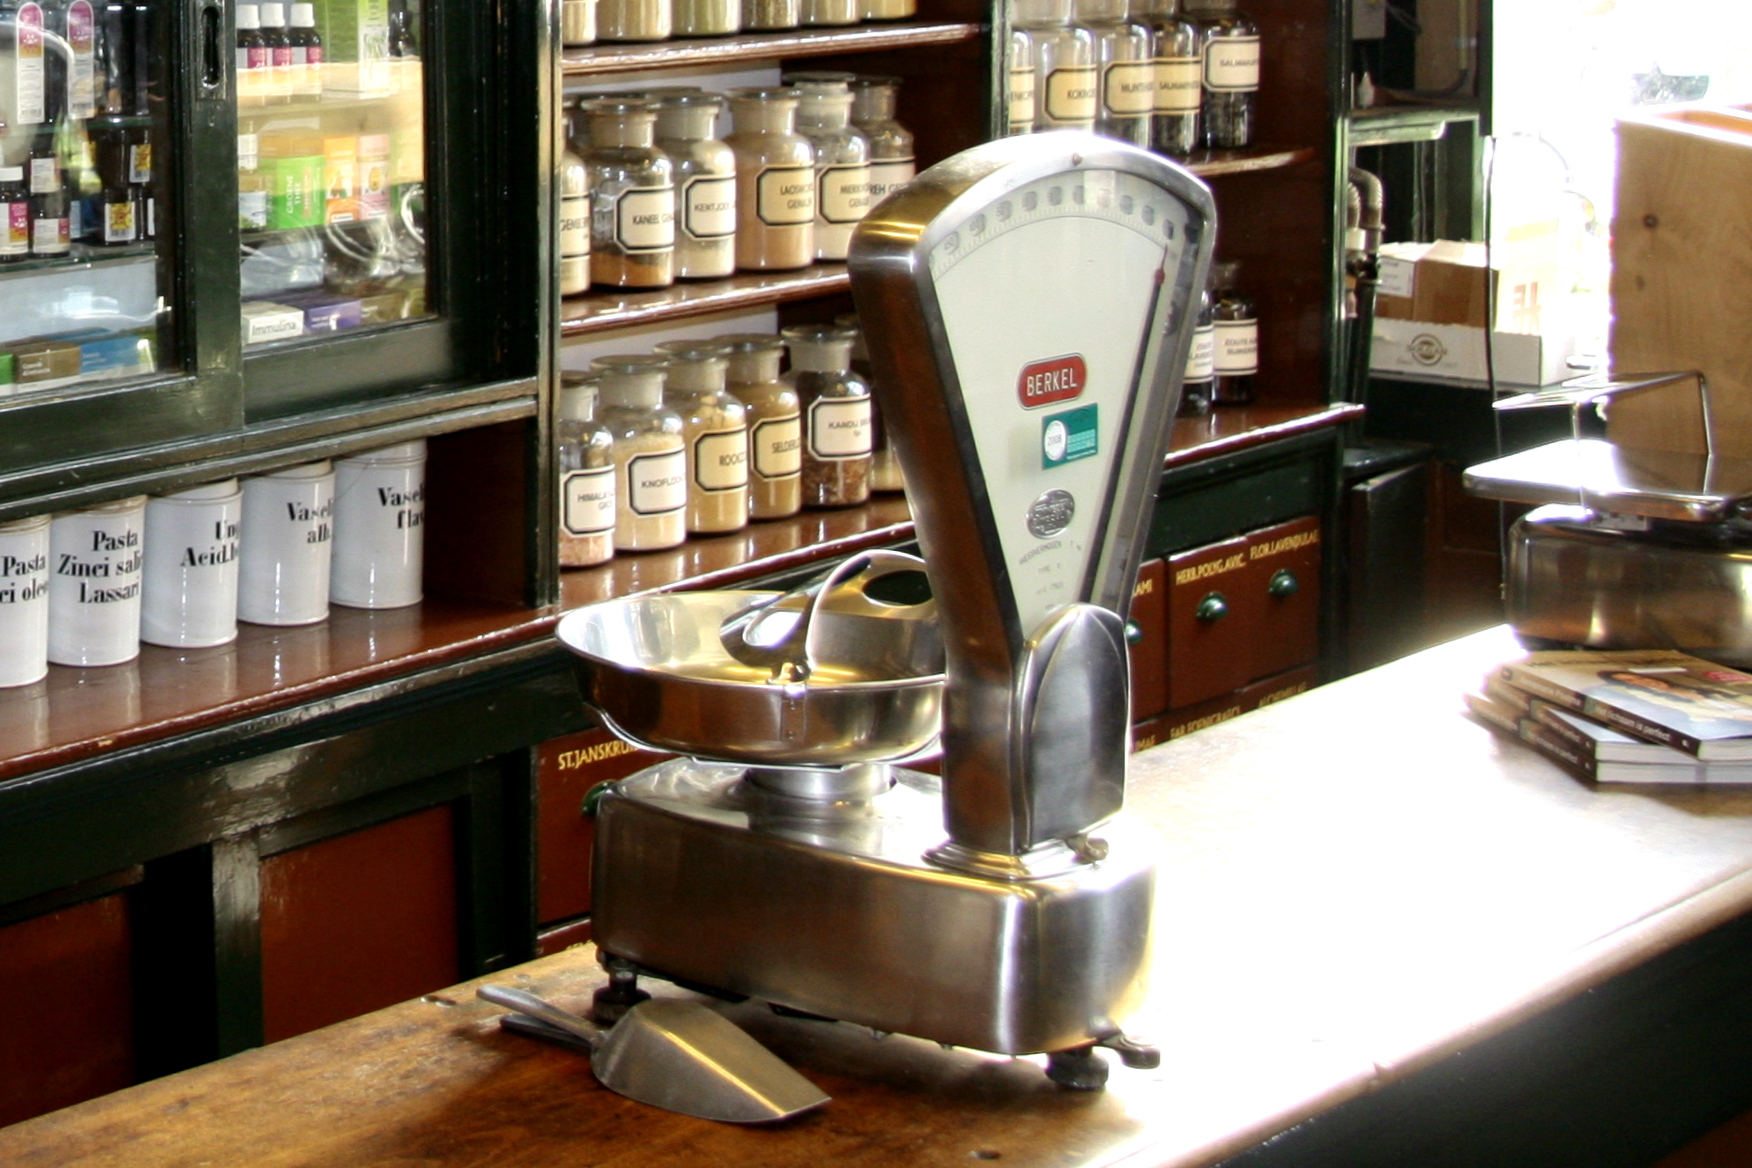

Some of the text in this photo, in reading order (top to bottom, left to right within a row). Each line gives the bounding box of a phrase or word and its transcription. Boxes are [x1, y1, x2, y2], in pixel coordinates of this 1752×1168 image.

[252, 319, 297, 336] Immulina
[1027, 367, 1078, 397] BERKEL
[92, 529, 139, 552] Pasta
[1, 553, 46, 578] Pasta
[57, 553, 110, 578] Zinci
